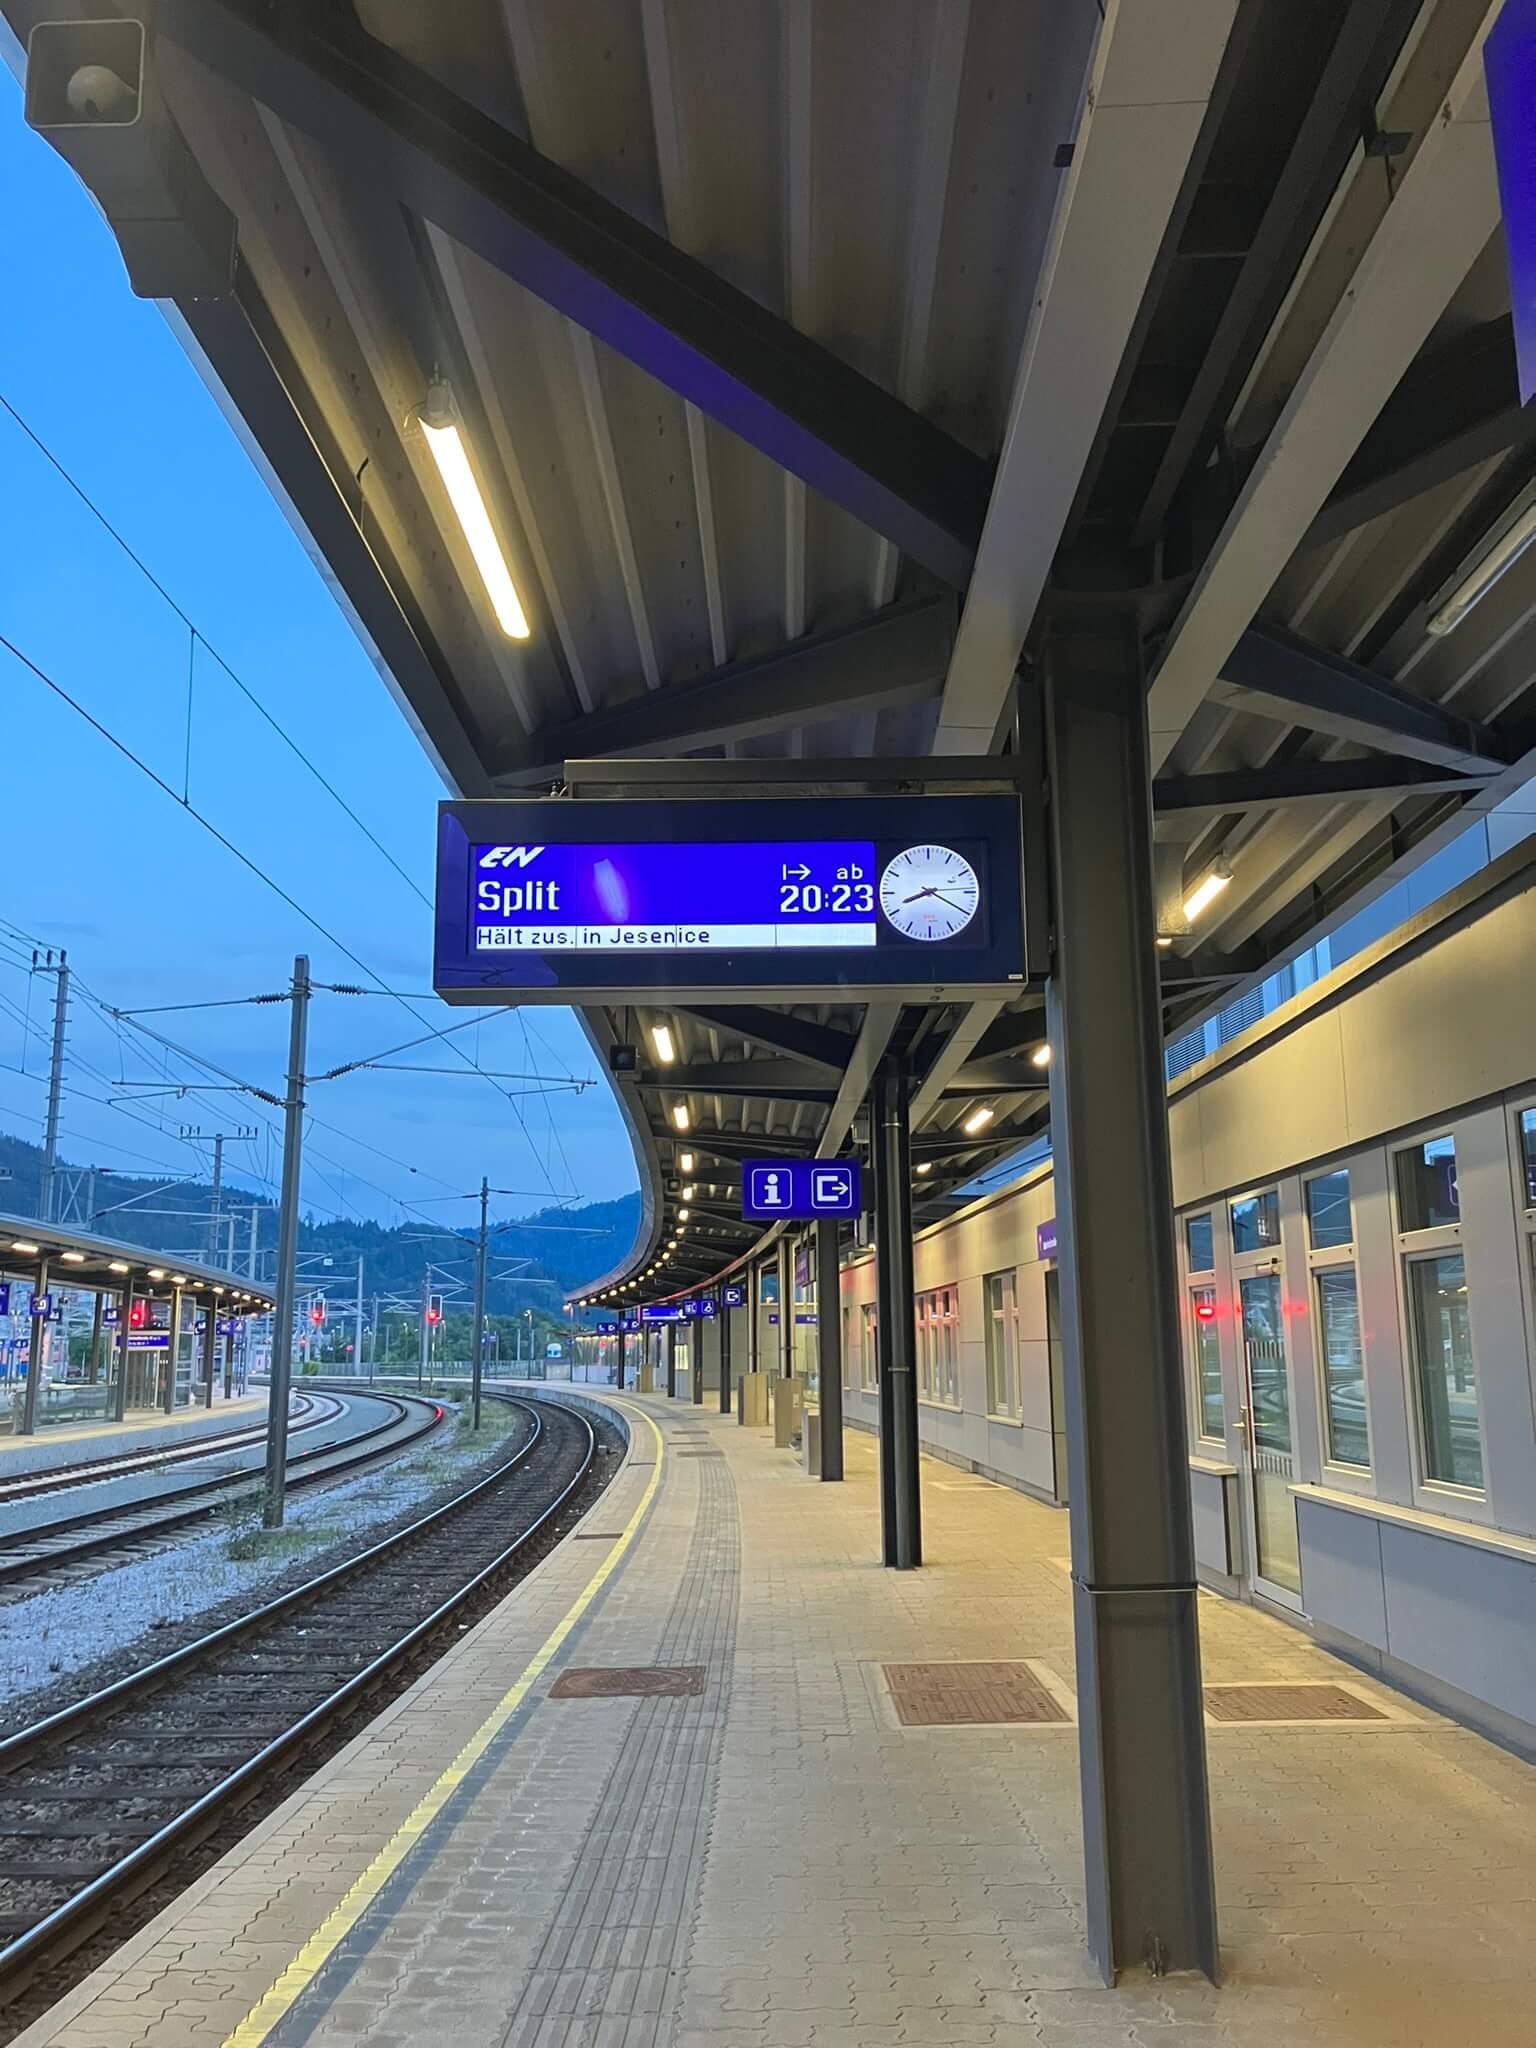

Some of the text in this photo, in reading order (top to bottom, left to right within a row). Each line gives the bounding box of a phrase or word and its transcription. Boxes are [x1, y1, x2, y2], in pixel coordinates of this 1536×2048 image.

[479, 847, 545, 868] EN
[836, 863, 864, 880] ab
[478, 880, 560, 917] Split
[780, 884, 874, 912] 20:23
[477, 928, 710, 945] Hält zus. in Jesenice
